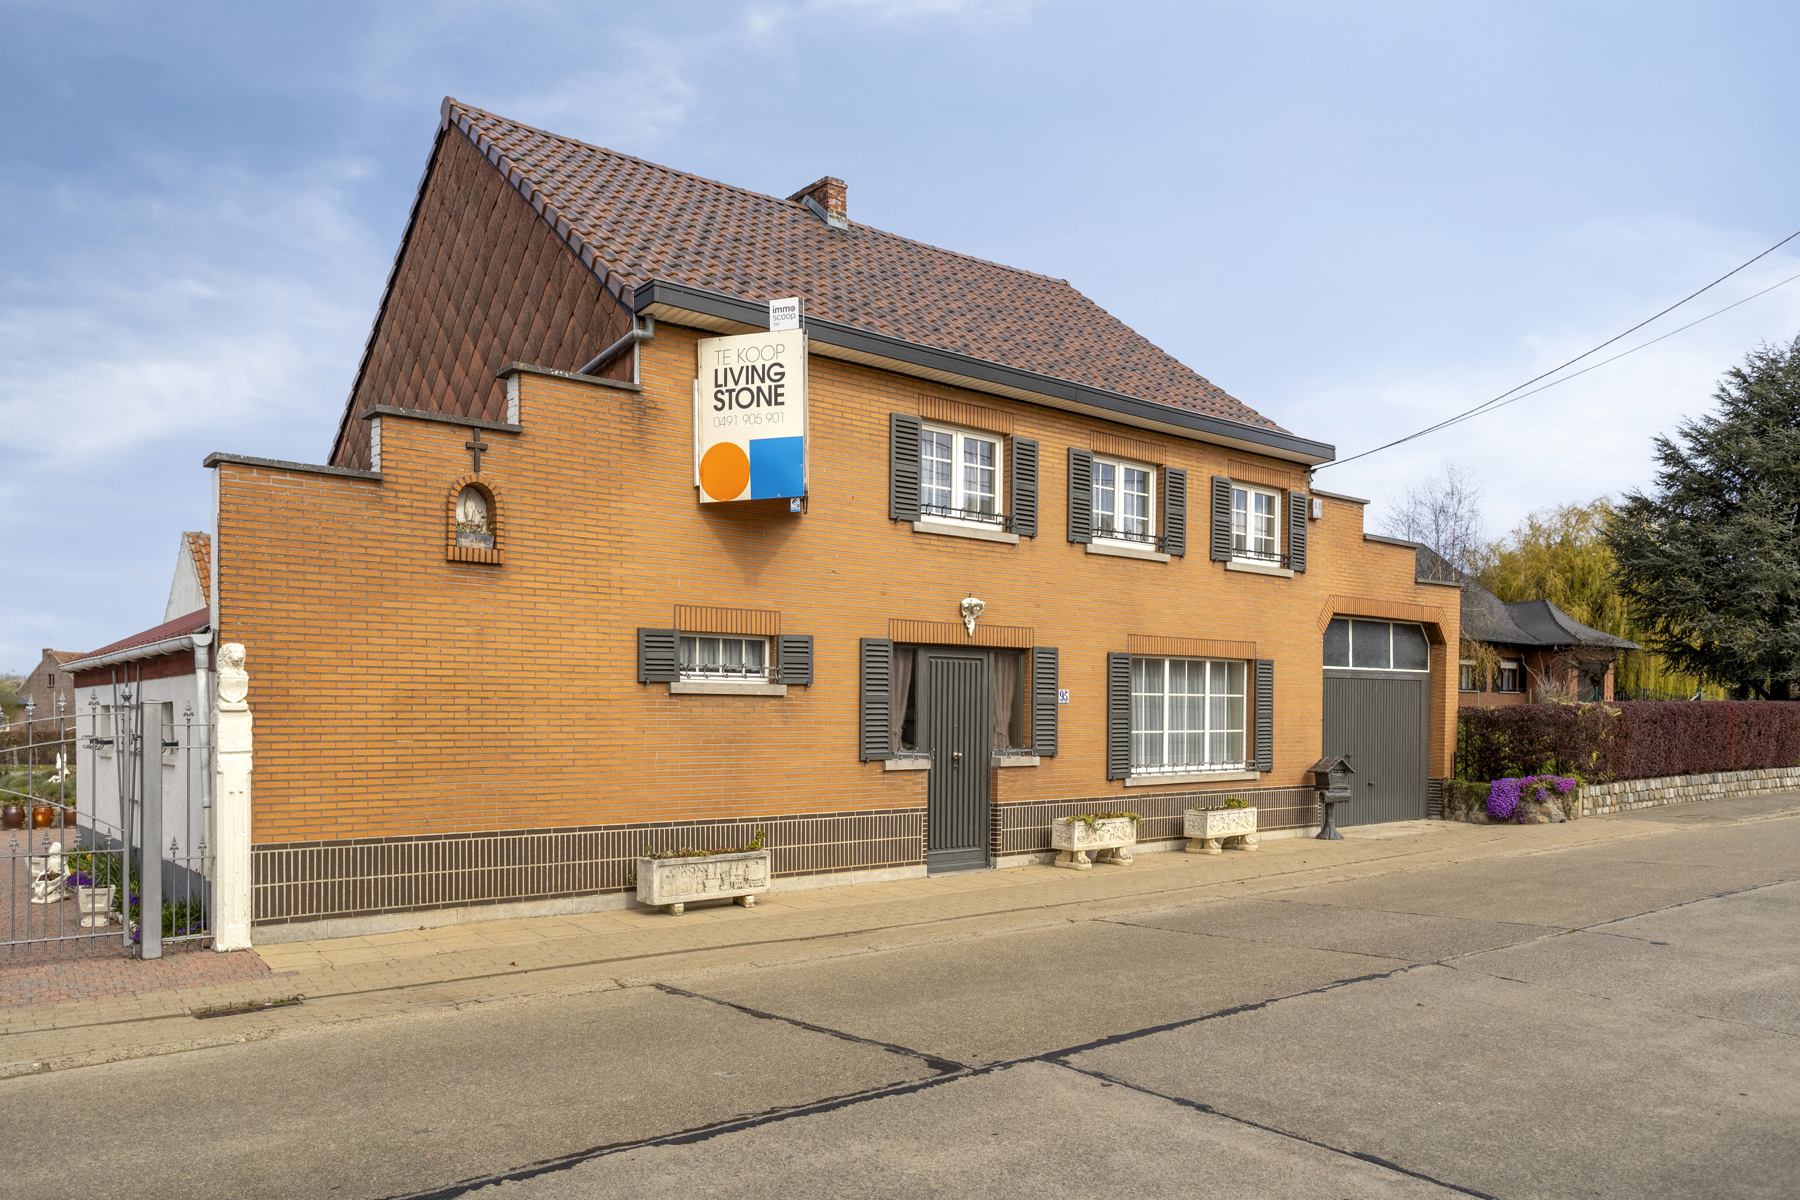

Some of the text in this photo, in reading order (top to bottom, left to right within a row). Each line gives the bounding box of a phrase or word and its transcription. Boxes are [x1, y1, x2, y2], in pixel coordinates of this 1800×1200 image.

[772, 305, 796, 314] immo
[772, 312, 796, 321] scoop
[714, 343, 785, 366] TE KOOP
[714, 362, 786, 388] LIVING
[713, 383, 785, 412] STONE
[713, 411, 784, 428] 0491 905 901
[1059, 689, 1069, 702] 95
